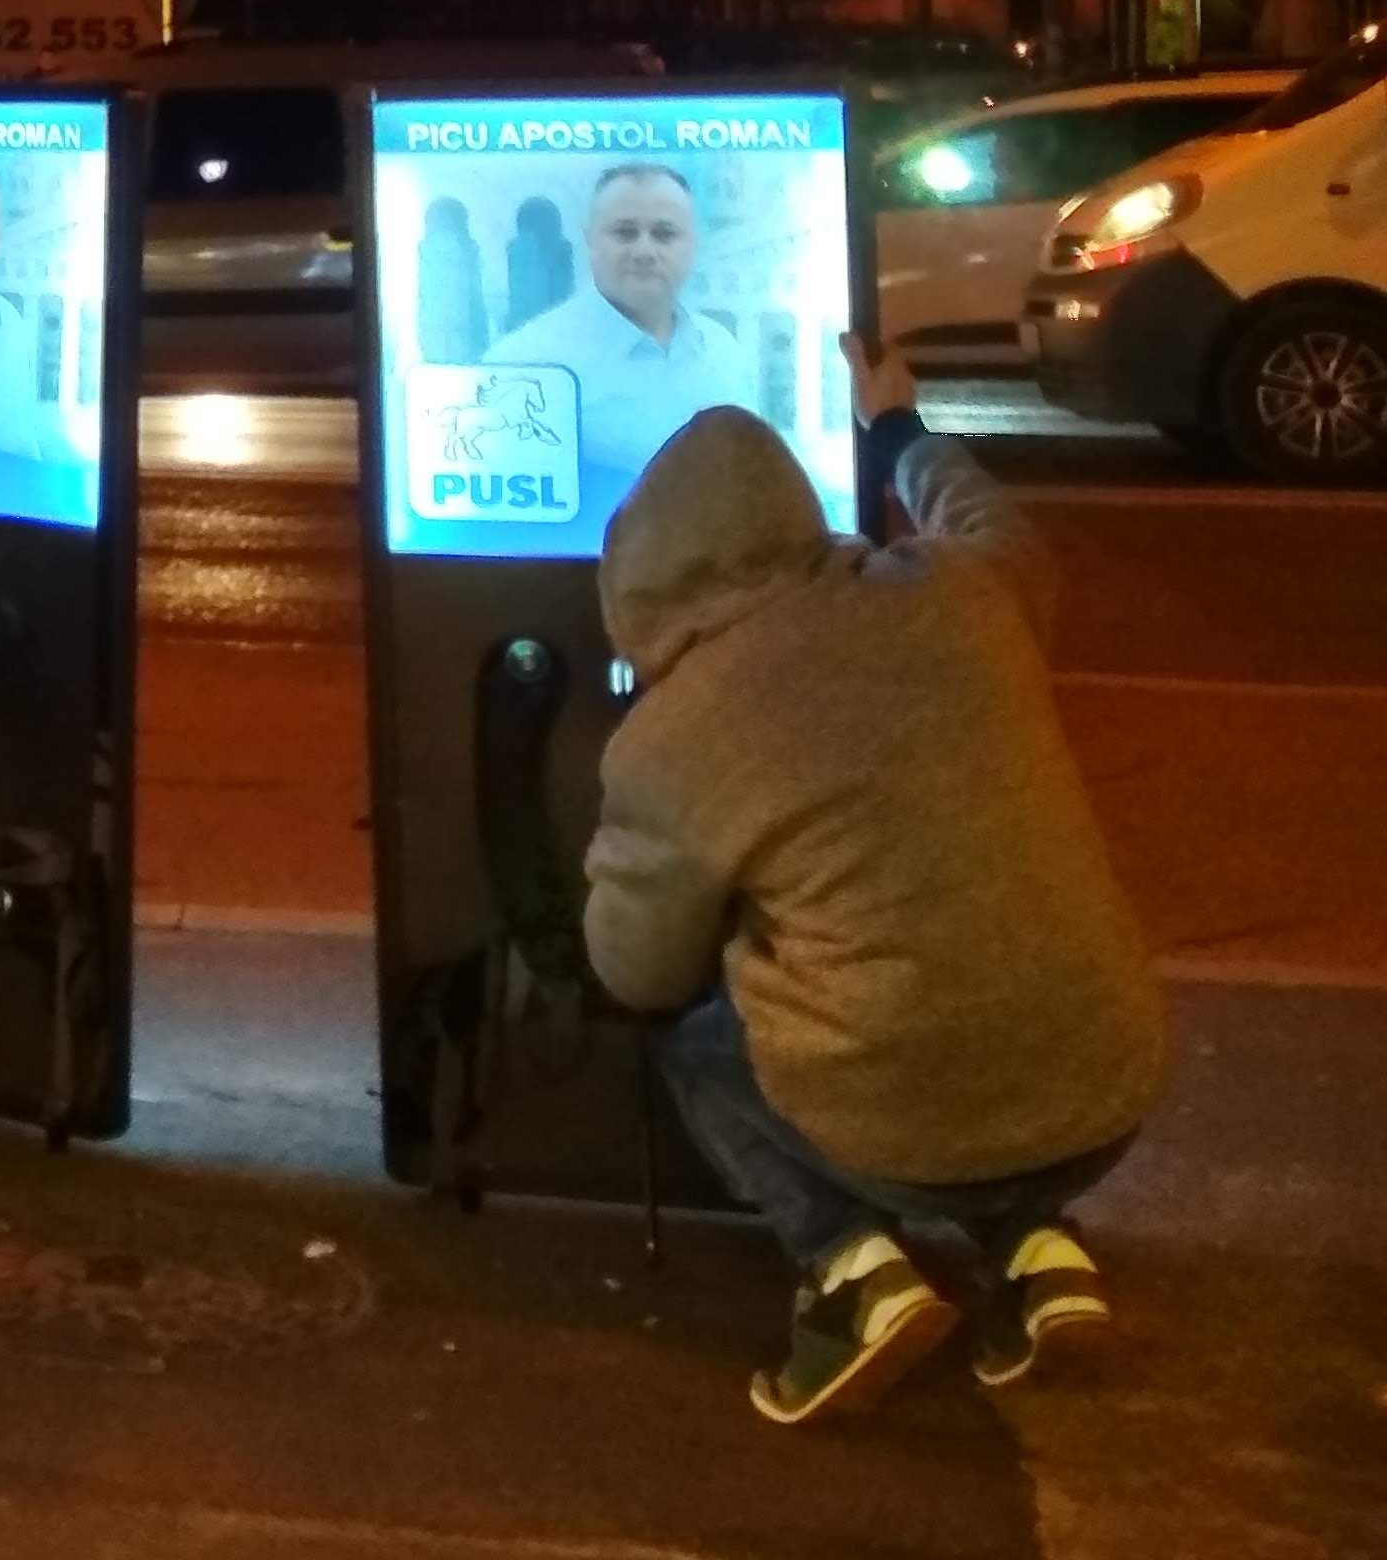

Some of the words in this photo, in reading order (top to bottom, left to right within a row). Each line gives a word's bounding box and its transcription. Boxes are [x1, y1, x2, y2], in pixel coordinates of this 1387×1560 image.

[49, 16, 139, 52] 553
[407, 121, 488, 151] PICU
[497, 120, 666, 150] APOSTOL
[675, 118, 812, 149] ROMAN
[433, 474, 567, 510] PUSL
